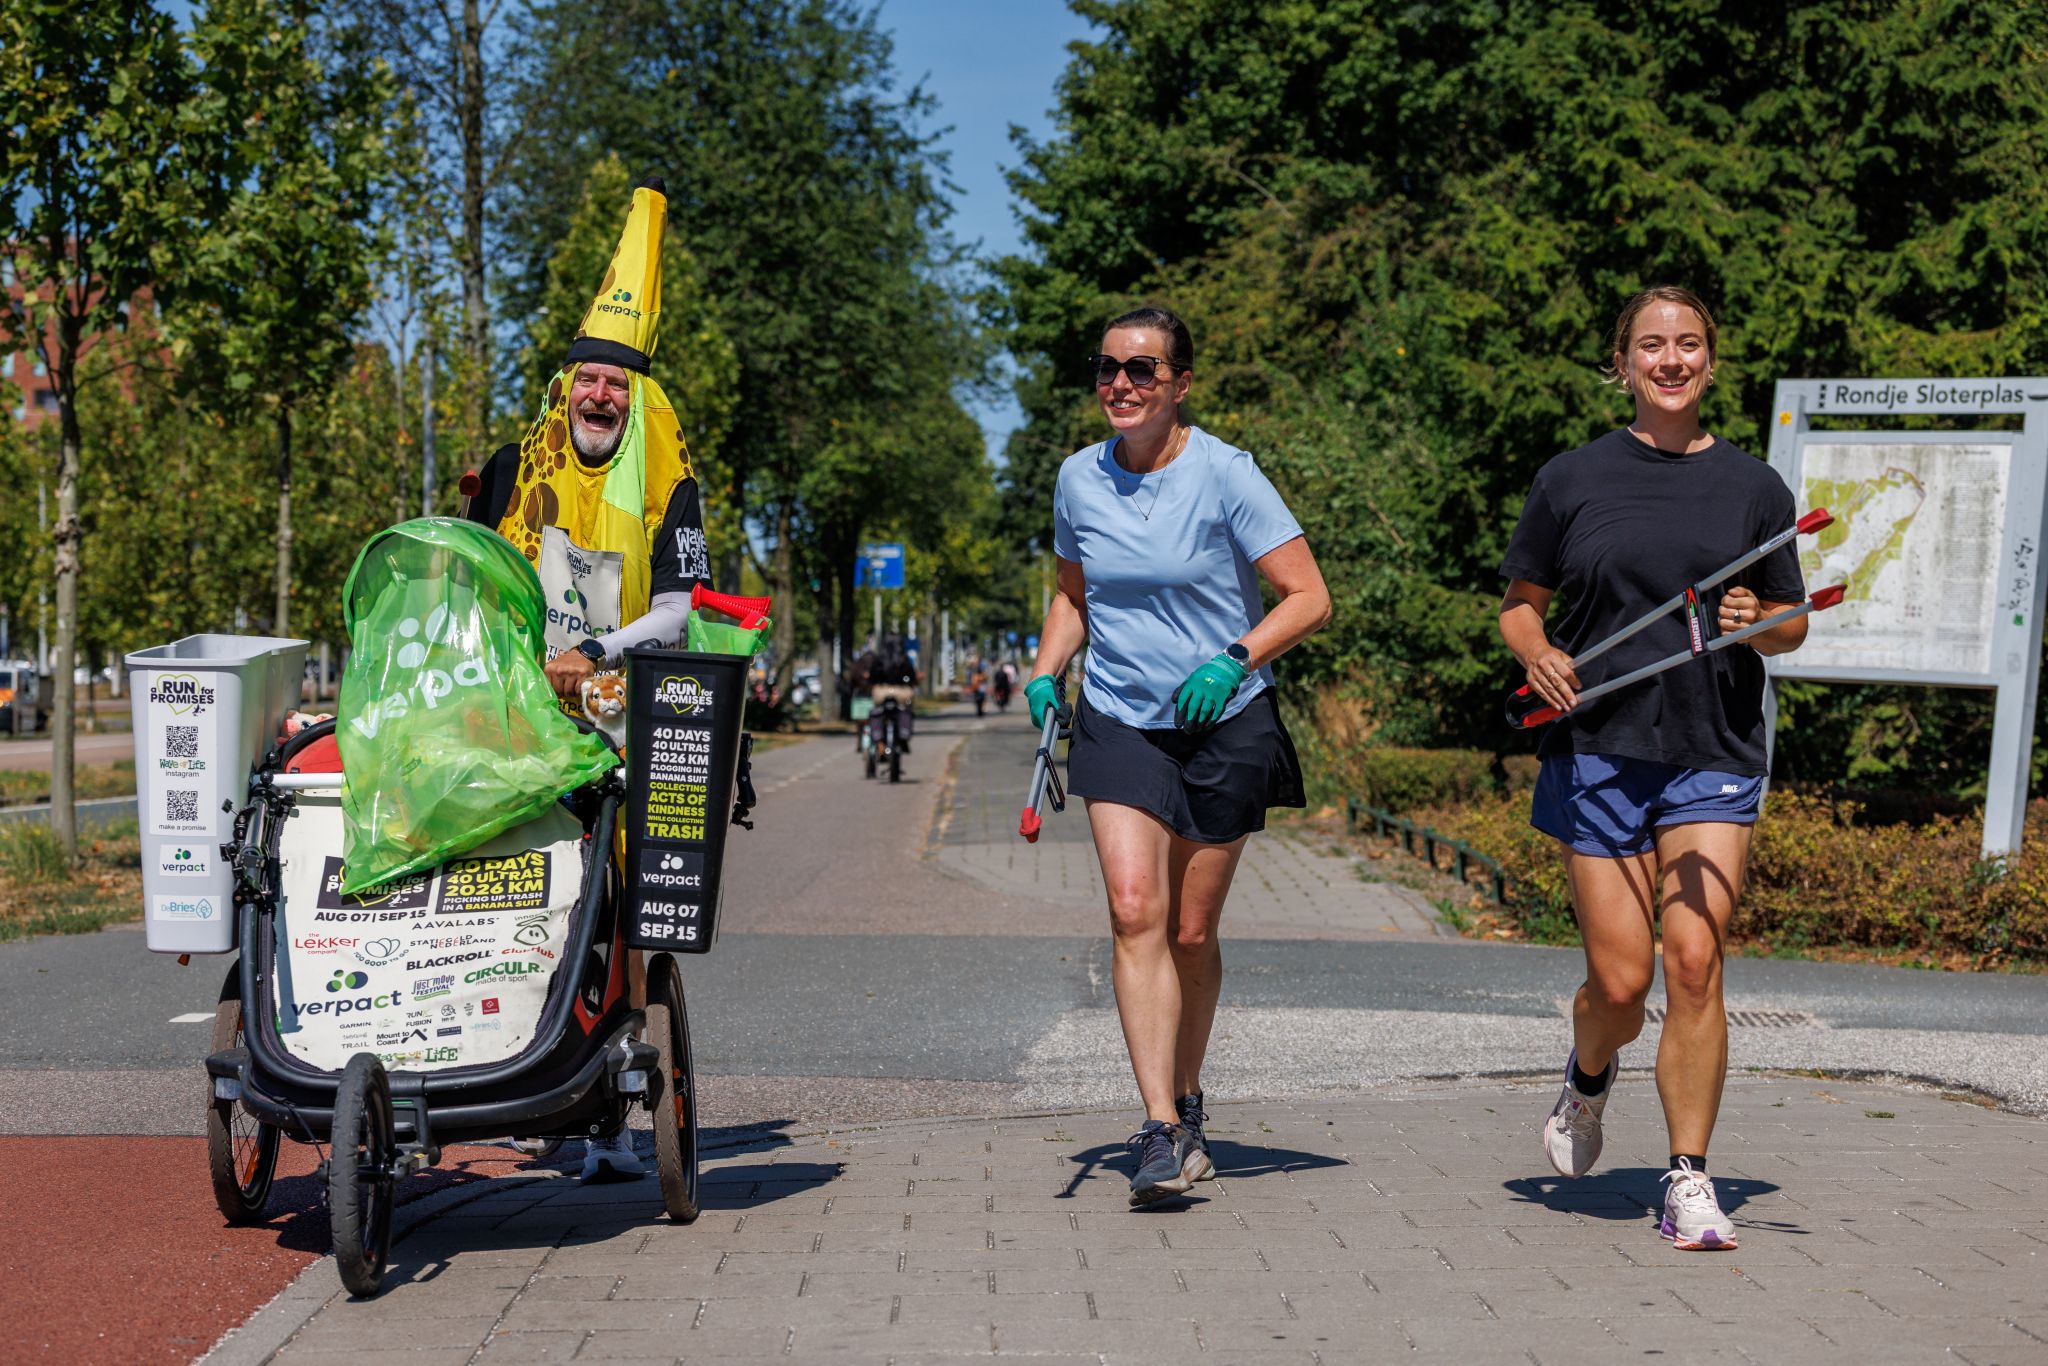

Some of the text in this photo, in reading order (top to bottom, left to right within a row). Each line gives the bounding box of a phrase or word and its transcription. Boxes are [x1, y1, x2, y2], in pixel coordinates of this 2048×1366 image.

[597, 303, 641, 320] verpact
[1835, 383, 2023, 410] Rondje Sloterplas
[547, 608, 615, 639] erpact
[1691, 616, 1702, 652] RANGER
[163, 681, 195, 694] RUN
[666, 682, 697, 695] RUN
[701, 689, 713, 697] for
[150, 694, 214, 704] PROMISES
[655, 694, 712, 705] PROMISES
[653, 728, 711, 742] 40 DAYS
[652, 741, 710, 753] 40 ULTRAS
[651, 751, 709, 765] 2026 KM
[165, 770, 200, 779] instagram
[650, 764, 692, 773] PLOGGING
[650, 772, 708, 783] BANANA SUIT
[649, 782, 707, 792] COLLECTING
[1721, 784, 1738, 793] NIKE
[648, 791, 707, 805] ACTS OF
[647, 804, 705, 817] KINDNESS
[646, 822, 705, 840] TRASH
[162, 863, 205, 873] verpact
[449, 852, 545, 873] 40 DAYS
[447, 867, 544, 884] 40 ULTRAS
[642, 872, 700, 887] verpact
[445, 879, 544, 897] 2026 KM
[443, 892, 543, 903] PICKING UP TRASH
[465, 901, 513, 910] BANANA
[515, 899, 542, 907] SUIT
[641, 901, 699, 918] AUG 07
[314, 912, 347, 922] AUG
[350, 913, 371, 922] 07
[378, 911, 409, 921] SEP
[409, 910, 427, 919] 15
[411, 918, 496, 930] AAVALABS
[640, 922, 697, 940] SEP 15
[406, 950, 492, 971] BLACKROLL
[475, 976, 497, 987] made
[508, 974, 528, 983] sport
[416, 984, 450, 995] FESTIVAL
[290, 990, 402, 1016] verpact
[339, 1021, 371, 1029] GARMIN
[405, 1018, 432, 1027] FUSION
[376, 1032, 401, 1040] Mount
[341, 1041, 370, 1049] TRAIL
